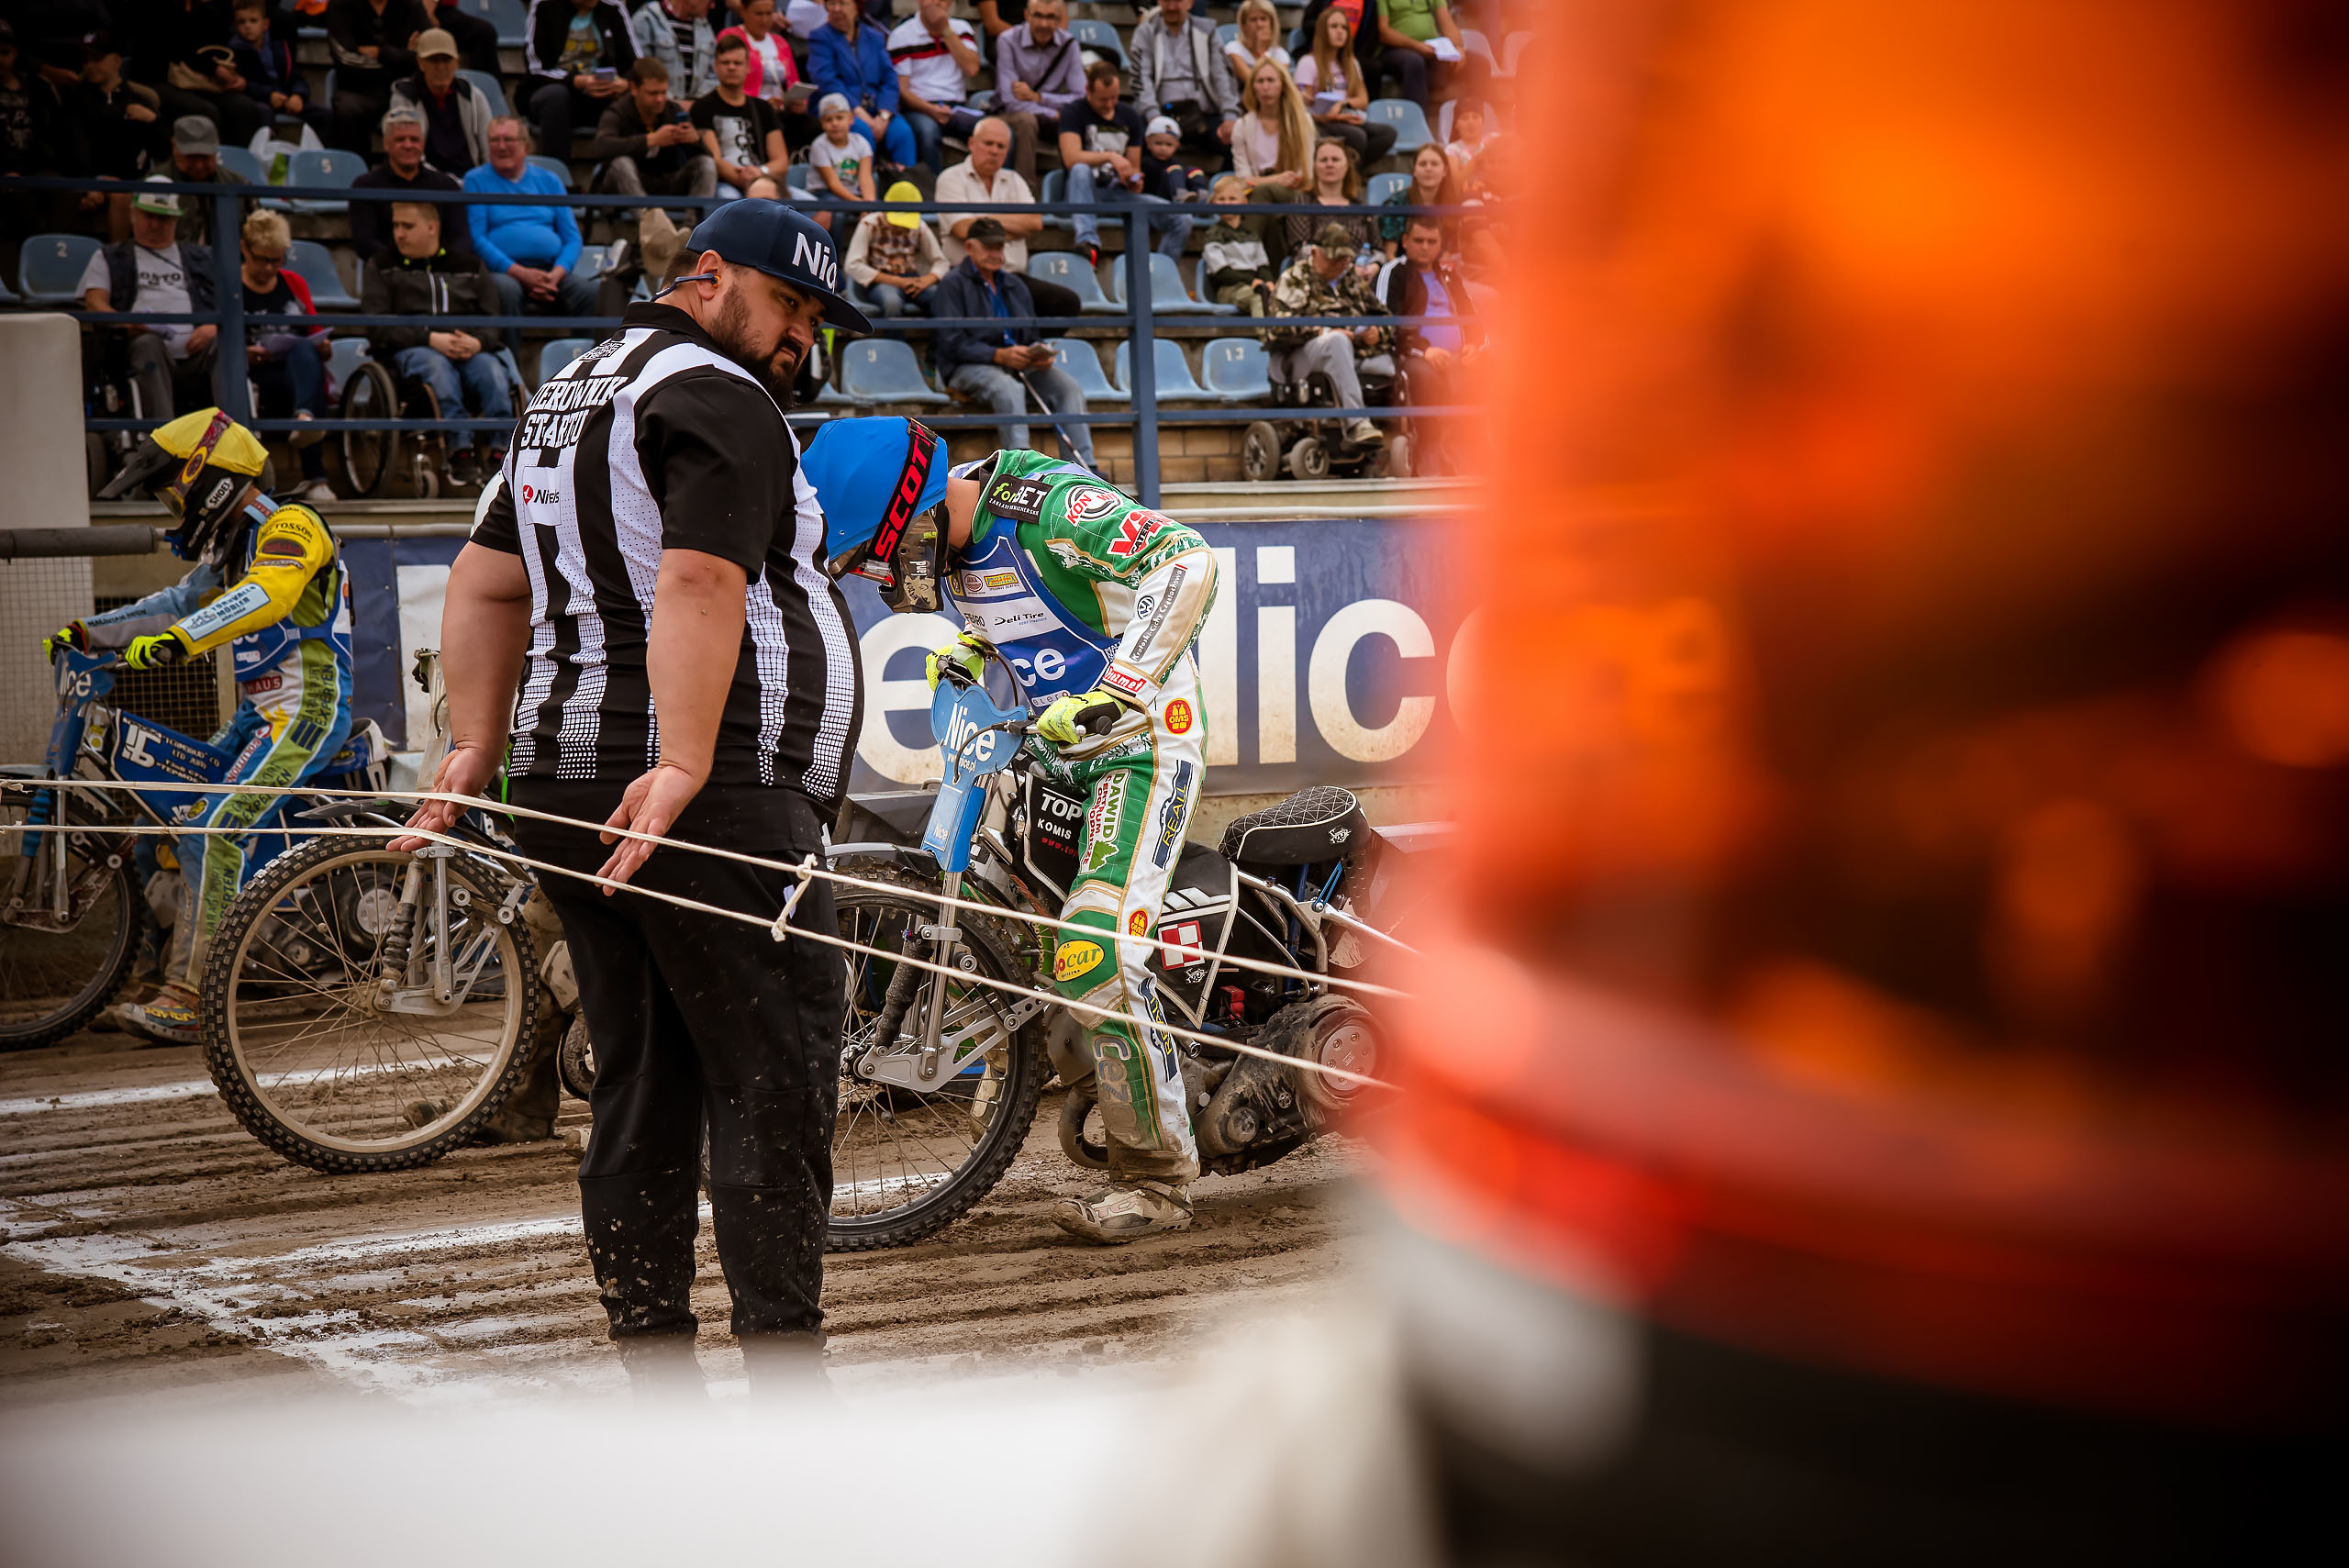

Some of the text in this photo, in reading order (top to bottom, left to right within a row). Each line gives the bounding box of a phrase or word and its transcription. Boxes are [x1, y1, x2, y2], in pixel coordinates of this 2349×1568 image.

[57, 241, 67, 258] 2
[792, 231, 837, 294] Nic
[1050, 260, 1068, 274] 12
[1226, 348, 1244, 361] 13
[520, 409, 590, 449] STARTU
[209, 482, 230, 506] SHOEI
[1067, 494, 1092, 524] KON
[1131, 518, 1163, 554] CATERI
[994, 615, 1021, 626] Deli
[59, 661, 92, 697] ice
[1011, 648, 1066, 687] ce
[315, 664, 335, 727] EXPERTEN
[944, 703, 996, 762] Nice
[1169, 716, 1189, 724] OMS
[242, 768, 293, 824] EXPEEN
[1041, 793, 1083, 821] TOP
[1095, 774, 1113, 834] CENTRUM
[1103, 773, 1125, 839] DAWID
[933, 823, 948, 840] Nice
[1037, 817, 1072, 840] KOMIS
[1163, 784, 1186, 847] REALL
[1130, 923, 1145, 935] OMS
